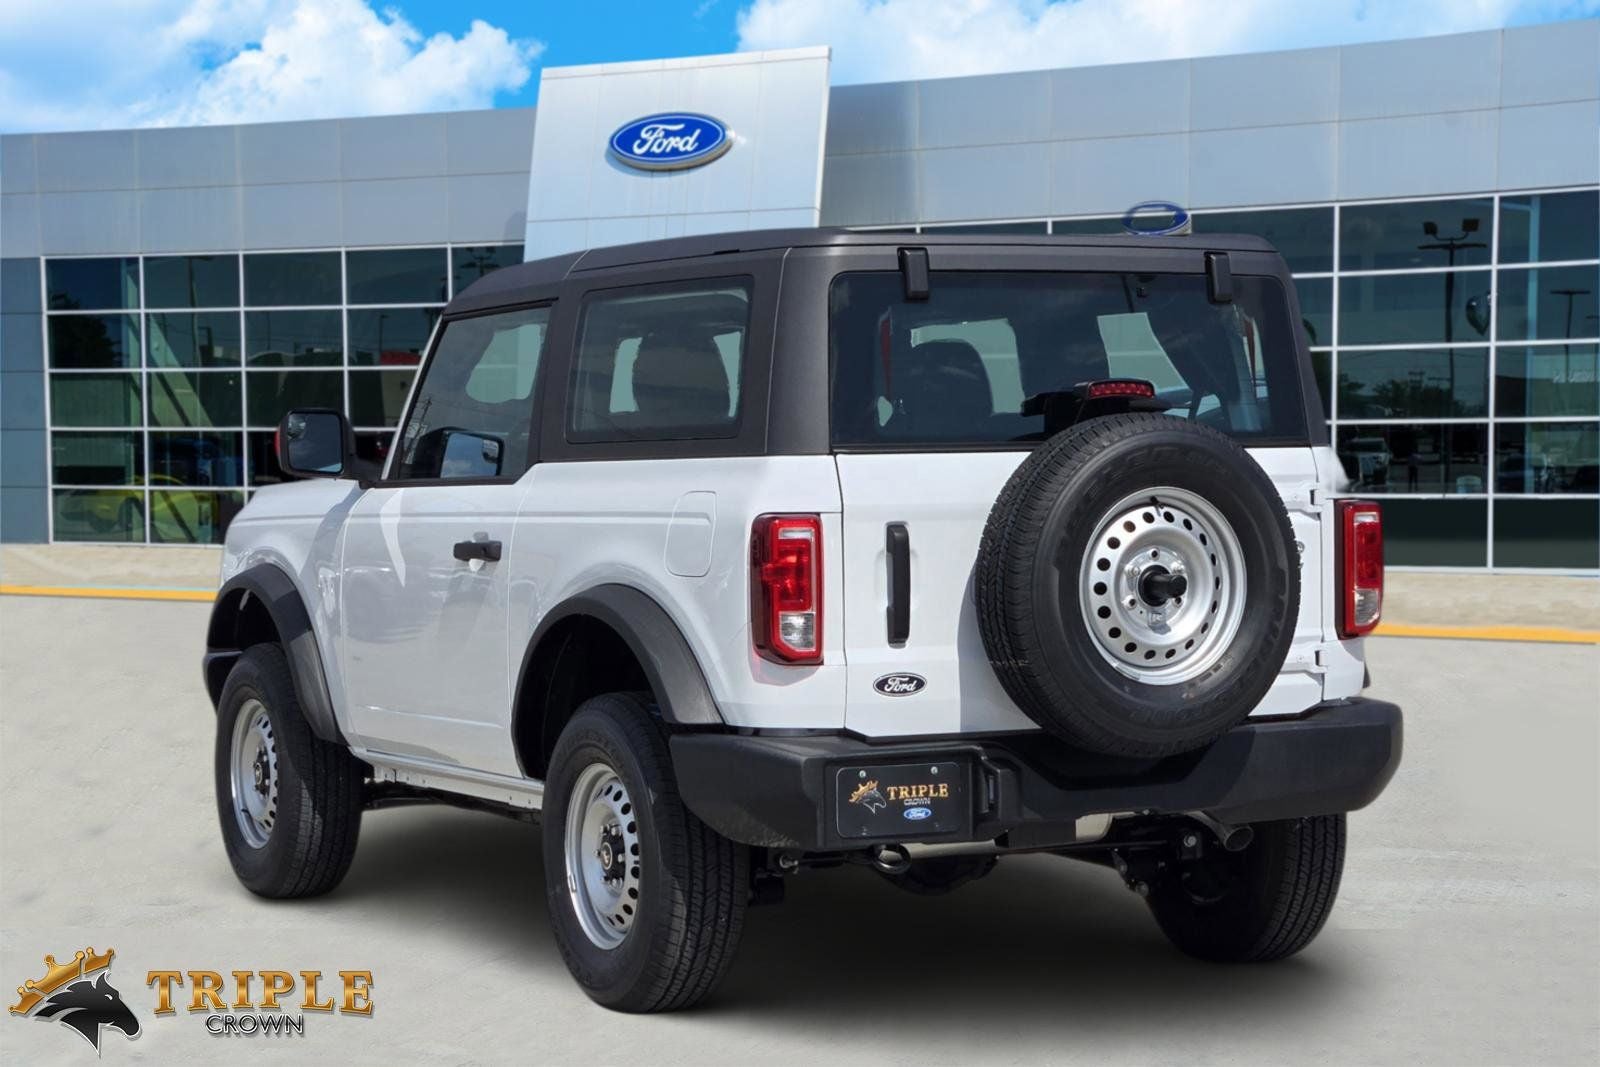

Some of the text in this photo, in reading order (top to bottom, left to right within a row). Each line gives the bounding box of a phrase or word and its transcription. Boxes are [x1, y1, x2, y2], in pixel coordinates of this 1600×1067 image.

[632, 123, 701, 155] Ford
[884, 677, 917, 691] Ford
[887, 783, 949, 800] TRIPLE
